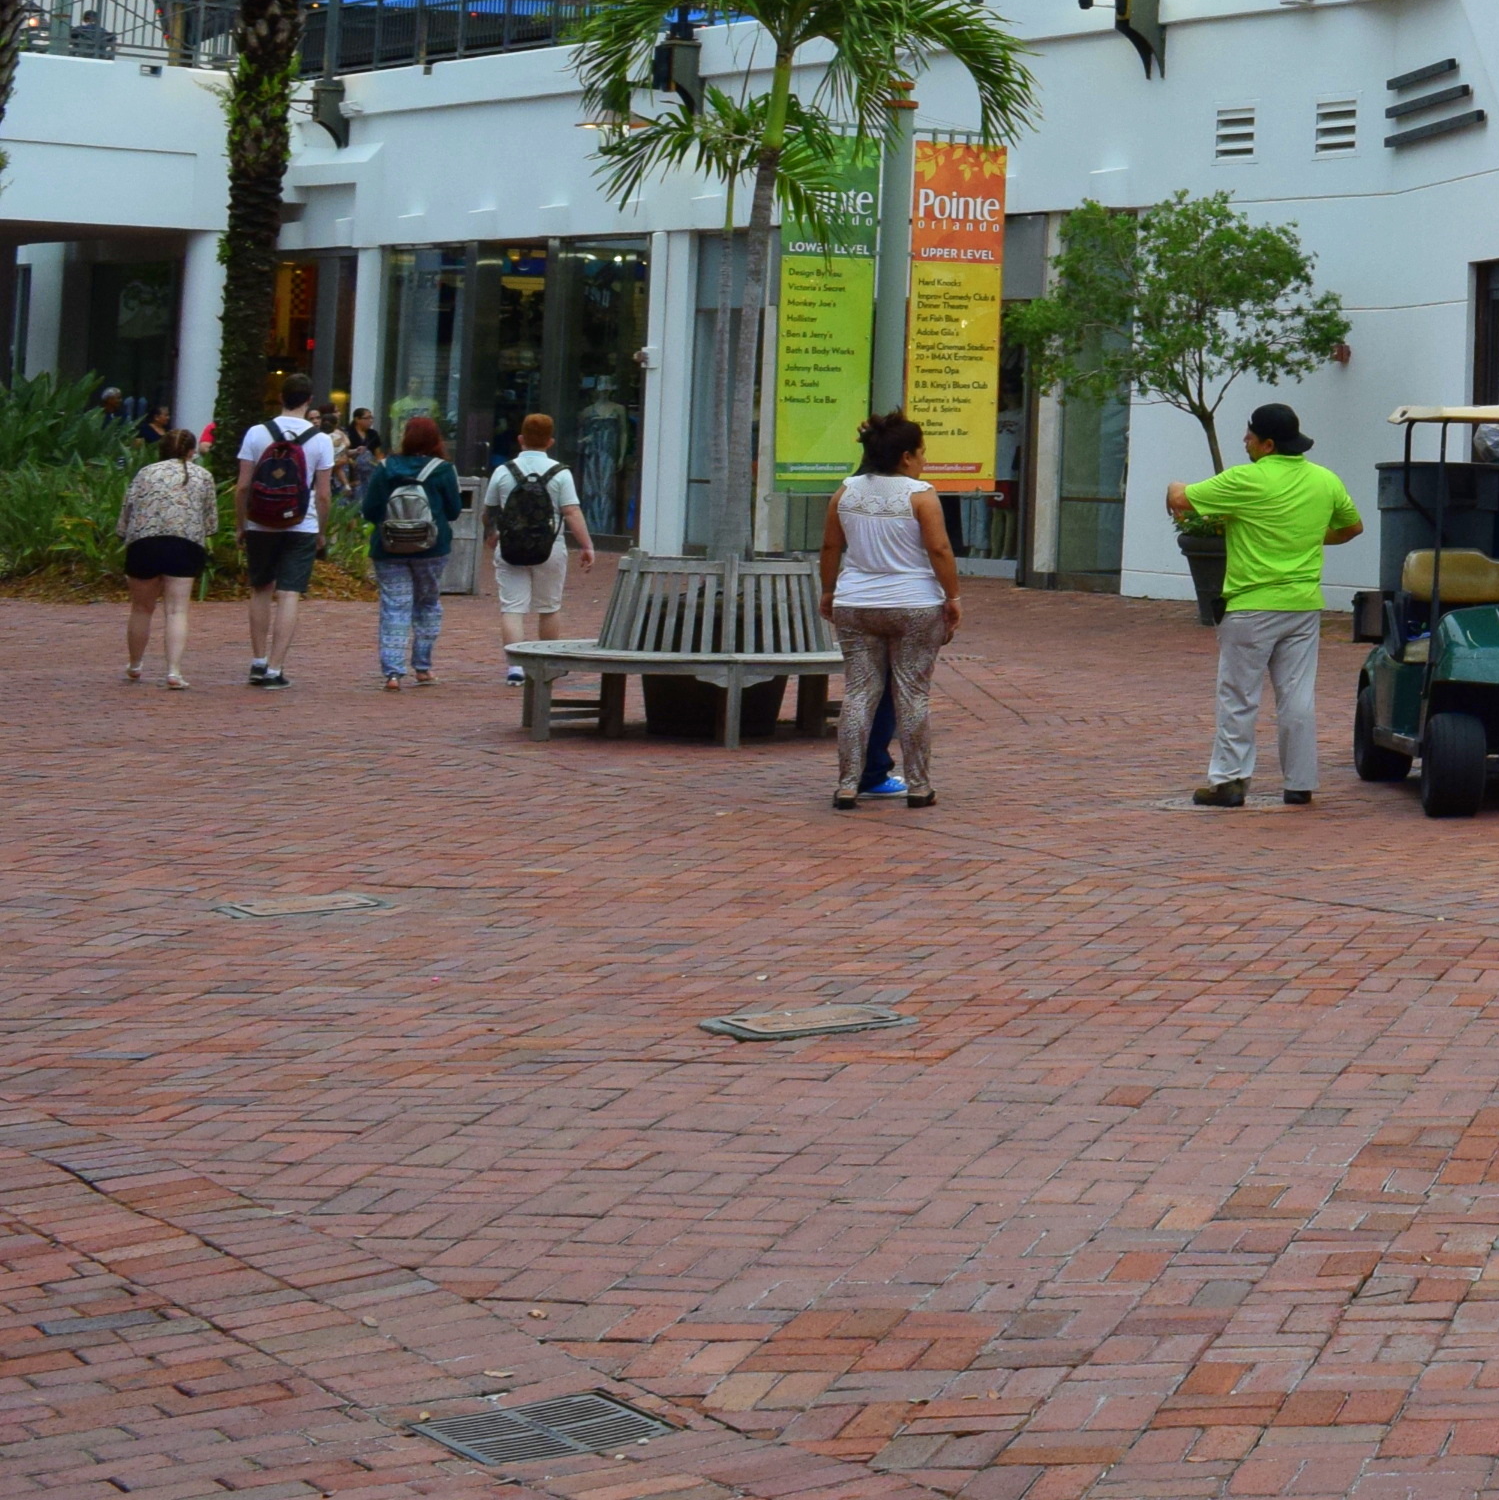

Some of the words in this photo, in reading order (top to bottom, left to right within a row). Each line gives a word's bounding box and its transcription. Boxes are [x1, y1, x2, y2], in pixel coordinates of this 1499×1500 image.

[918, 188, 1000, 221] Pointe
[918, 219, 999, 232] orlando
[921, 247, 958, 258] UPPER
[961, 249, 994, 260] LEVEL
[788, 267, 814, 278] Design
[816, 269, 825, 278] By
[788, 282, 822, 292] Victoria's
[823, 283, 846, 292] Secret
[918, 278, 935, 286] Hard
[937, 279, 962, 287] Knocks
[917, 292, 941, 300] Improv
[943, 292, 972, 302] Comedy
[973, 293, 989, 301] Club
[787, 299, 817, 308] Monkey
[818, 300, 836, 308] Joe's
[917, 301, 941, 309] Dinner
[942, 301, 968, 309] Theatre
[786, 314, 817, 322] Hollister
[916, 314, 928, 322] Fat
[930, 314, 943, 322] Fish
[786, 330, 801, 338] Ben
[809, 330, 833, 340] Jerry's
[916, 328, 939, 336] Adobe
[786, 346, 802, 354] Bath
[811, 346, 830, 356] Body
[916, 342, 935, 351] Regal
[937, 342, 966, 350] Cinemas
[967, 343, 995, 351] Stadium
[954, 353, 983, 361] Entrance
[785, 364, 812, 373] Johnny
[813, 364, 842, 372] Rockets
[915, 366, 942, 374] Taverna
[944, 366, 959, 375] Opa
[800, 380, 819, 388] Sushi
[930, 381, 951, 390] King's
[953, 381, 970, 389] Blues
[972, 381, 987, 389] Club
[813, 396, 823, 404] Ice
[825, 396, 837, 404] Bar
[952, 396, 971, 404] Music
[940, 405, 961, 413] Spirits
[922, 464, 976, 472] ointeorlando.com
